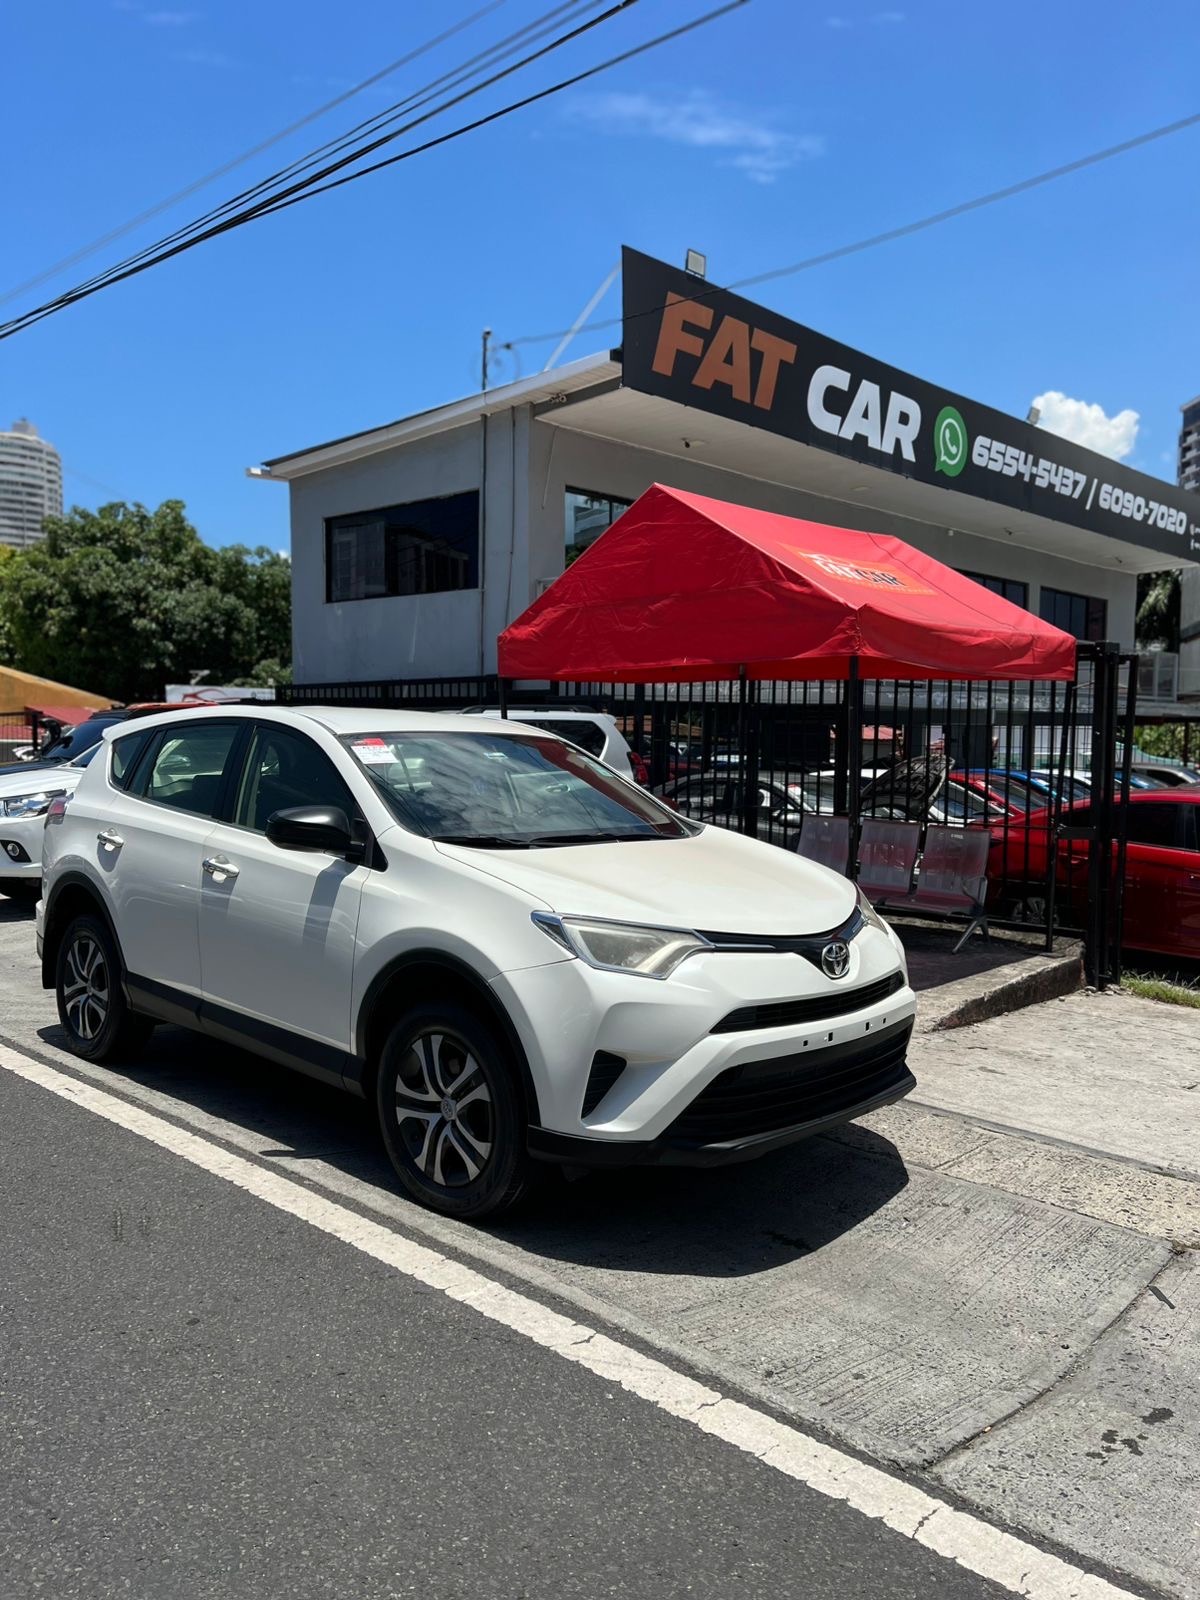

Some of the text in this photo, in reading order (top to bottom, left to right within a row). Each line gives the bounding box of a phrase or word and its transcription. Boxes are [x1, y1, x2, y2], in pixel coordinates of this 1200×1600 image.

[652, 291, 921, 462] FAT CAR
[972, 435, 1087, 499] 6554-5437
[1099, 483, 1187, 535] 6090-7020
